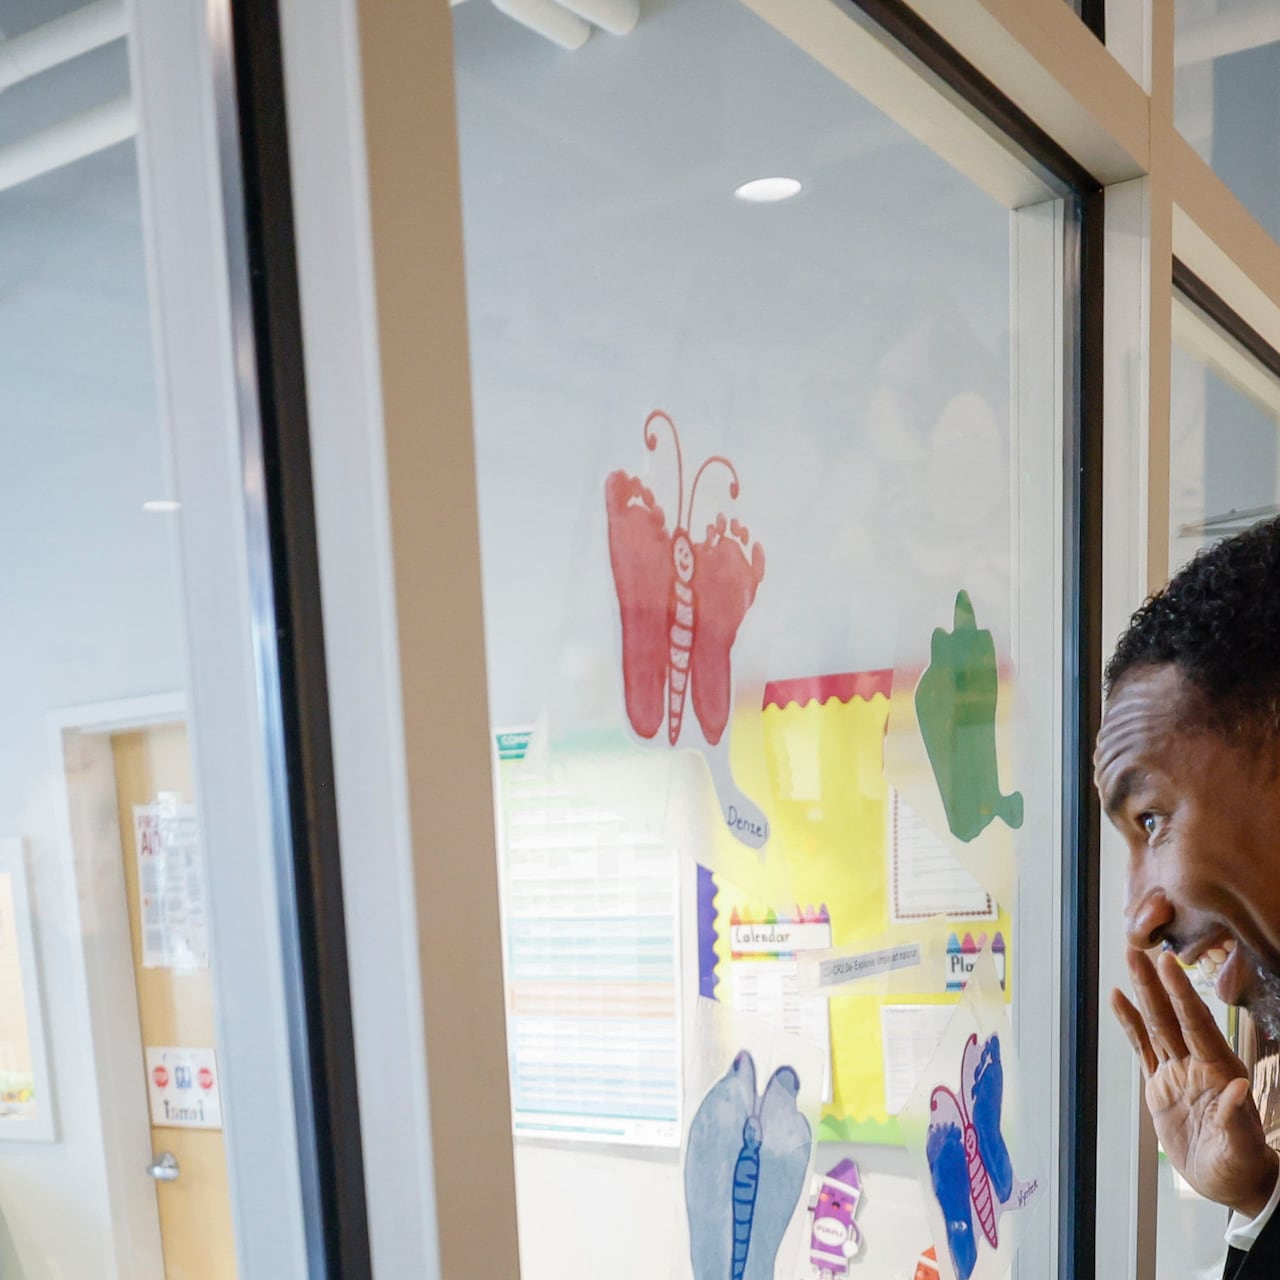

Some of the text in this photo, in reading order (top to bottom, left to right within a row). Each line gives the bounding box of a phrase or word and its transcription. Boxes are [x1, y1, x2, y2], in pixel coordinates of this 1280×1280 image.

[727, 805, 769, 839] Denzel
[735, 925, 790, 943] Calendar
[951, 954, 976, 973] Pla
[817, 1225, 843, 1238] PURPLE
